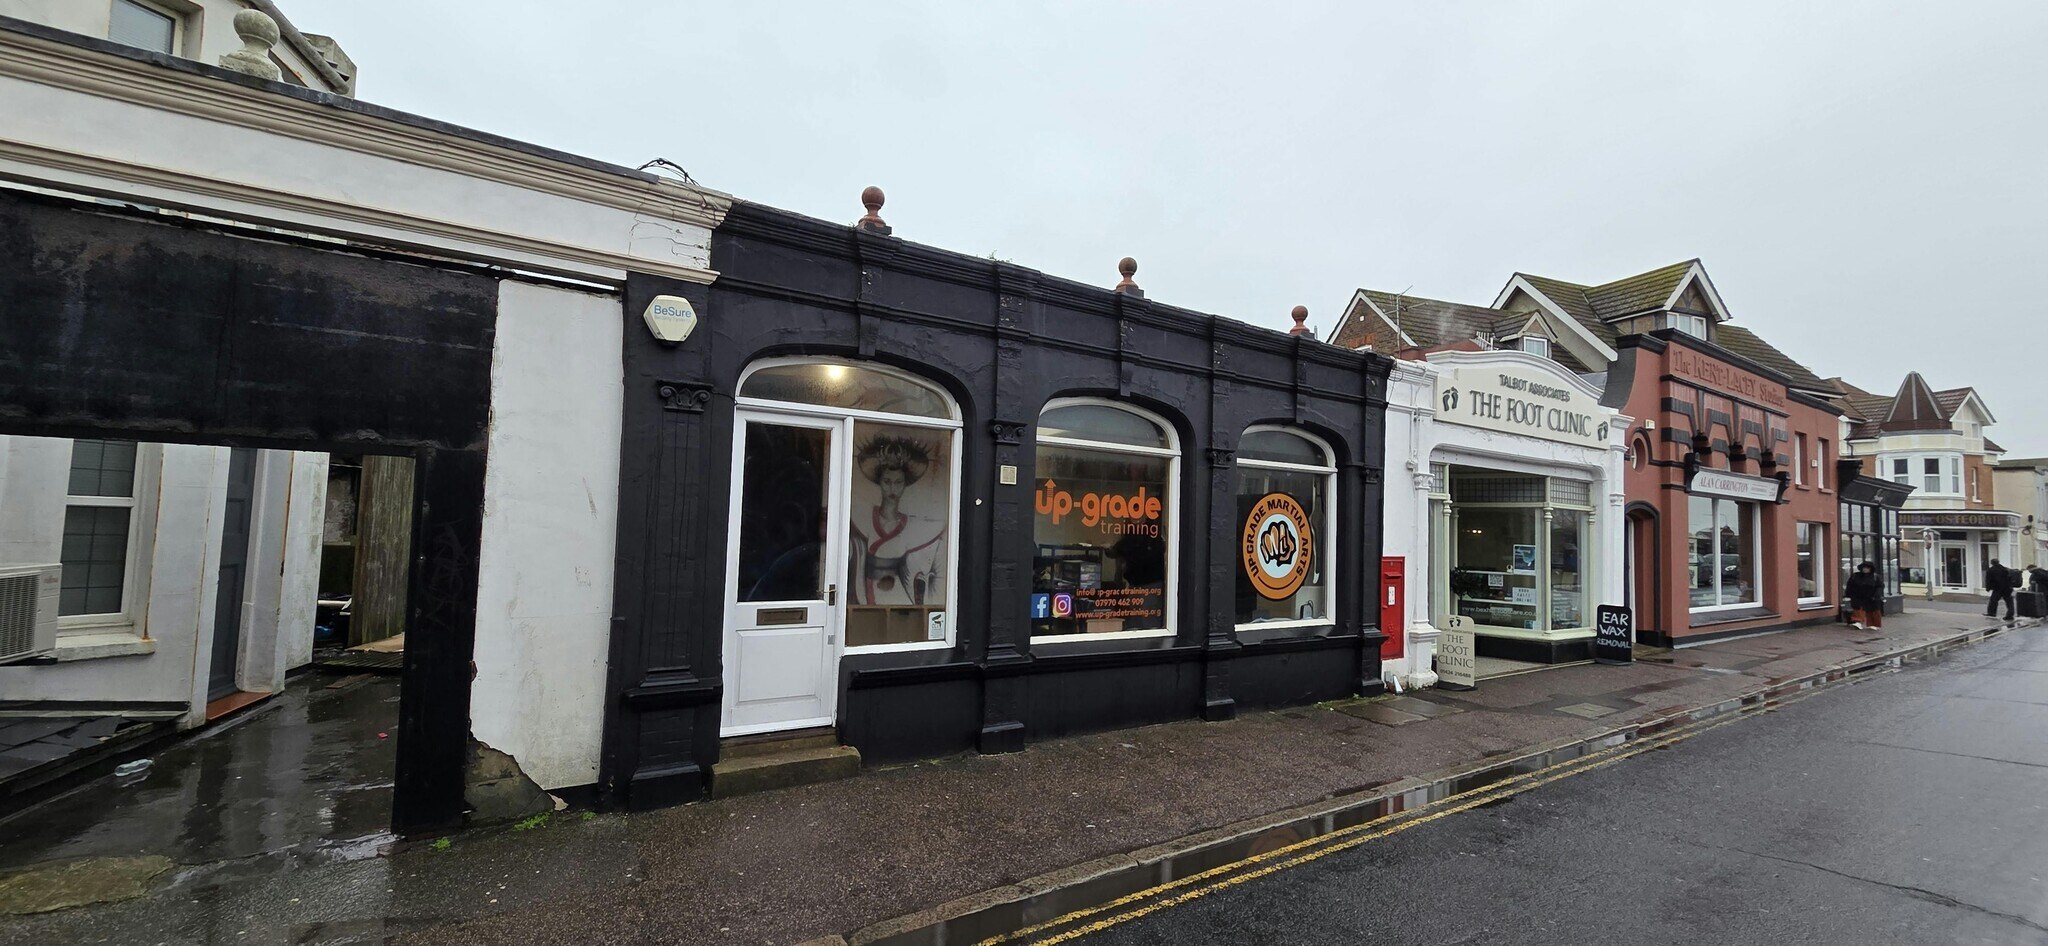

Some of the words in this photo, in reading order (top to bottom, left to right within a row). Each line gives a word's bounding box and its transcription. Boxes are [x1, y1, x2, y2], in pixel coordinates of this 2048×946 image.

[654, 305, 691, 317] BeSure
[1499, 374, 1528, 391] TALBOT
[1528, 382, 1570, 402] ASSOCIATES
[1469, 389, 1501, 419] THE
[1507, 397, 1544, 428] FOOT
[1548, 407, 1592, 437] CLINIC
[1035, 486, 1162, 528] up-grade
[1101, 520, 1159, 539] training
[1246, 505, 1267, 578] UP-GRADE
[1267, 499, 1306, 534] MARTIAL
[1296, 537, 1309, 577] ARTS
[1095, 598, 1116, 607] 07970
[1118, 598, 1131, 606] 462
[1132, 598, 1144, 606] 909
[1602, 612, 1629, 626] EAR
[1599, 624, 1626, 637] WAX
[1446, 634, 1464, 644] THE
[1597, 638, 1632, 648] REMOVAL
[1442, 644, 1469, 656] FOOT
[1438, 655, 1473, 668] CLINIC
